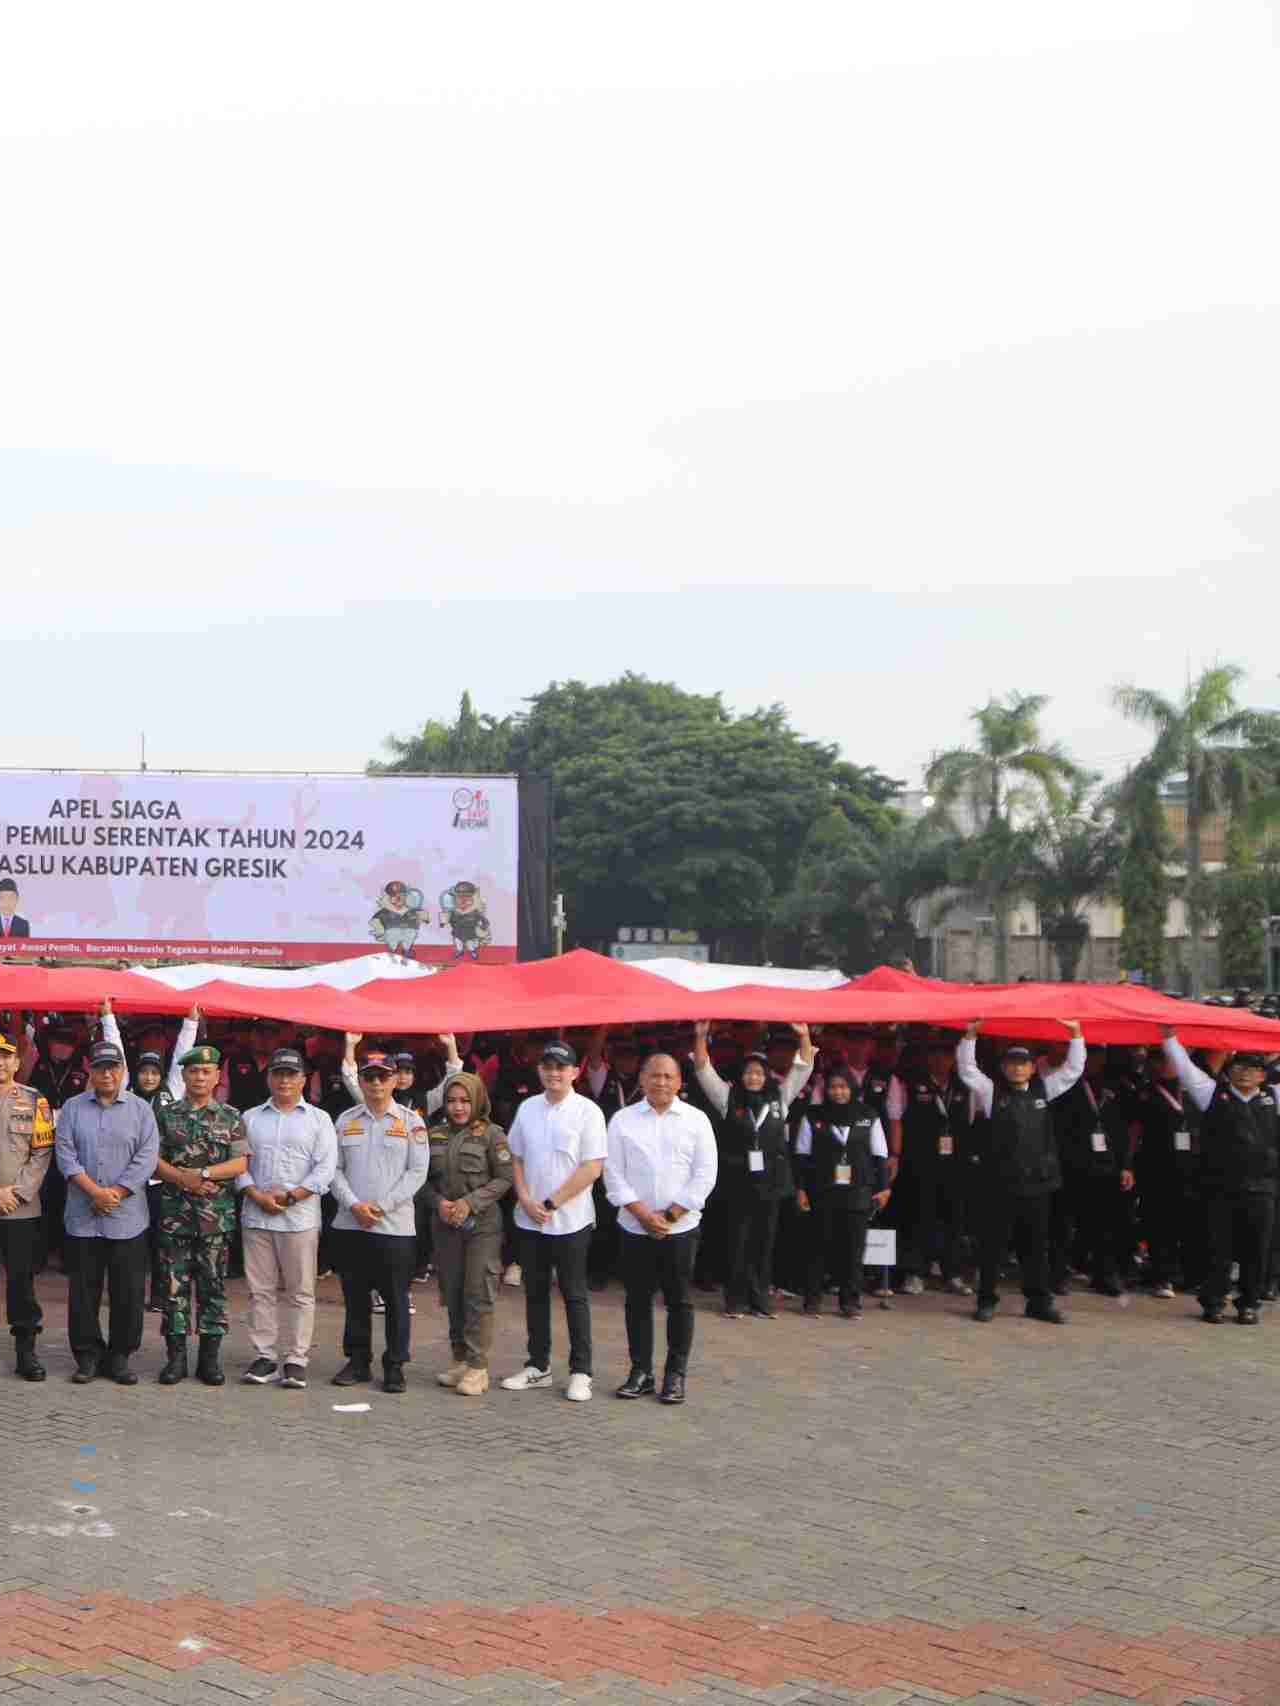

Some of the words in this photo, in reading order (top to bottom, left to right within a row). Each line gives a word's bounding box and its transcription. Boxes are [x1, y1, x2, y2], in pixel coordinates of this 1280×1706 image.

[49, 799, 104, 820] APEL
[111, 799, 182, 820] SIAGA
[6, 826, 87, 846] PEMILU
[93, 826, 210, 848] SERENTAK
[217, 828, 296, 849] TAHUN
[303, 829, 365, 850] 2024
[61, 855, 198, 877] KABUPATEN
[205, 857, 288, 879] GRESIK
